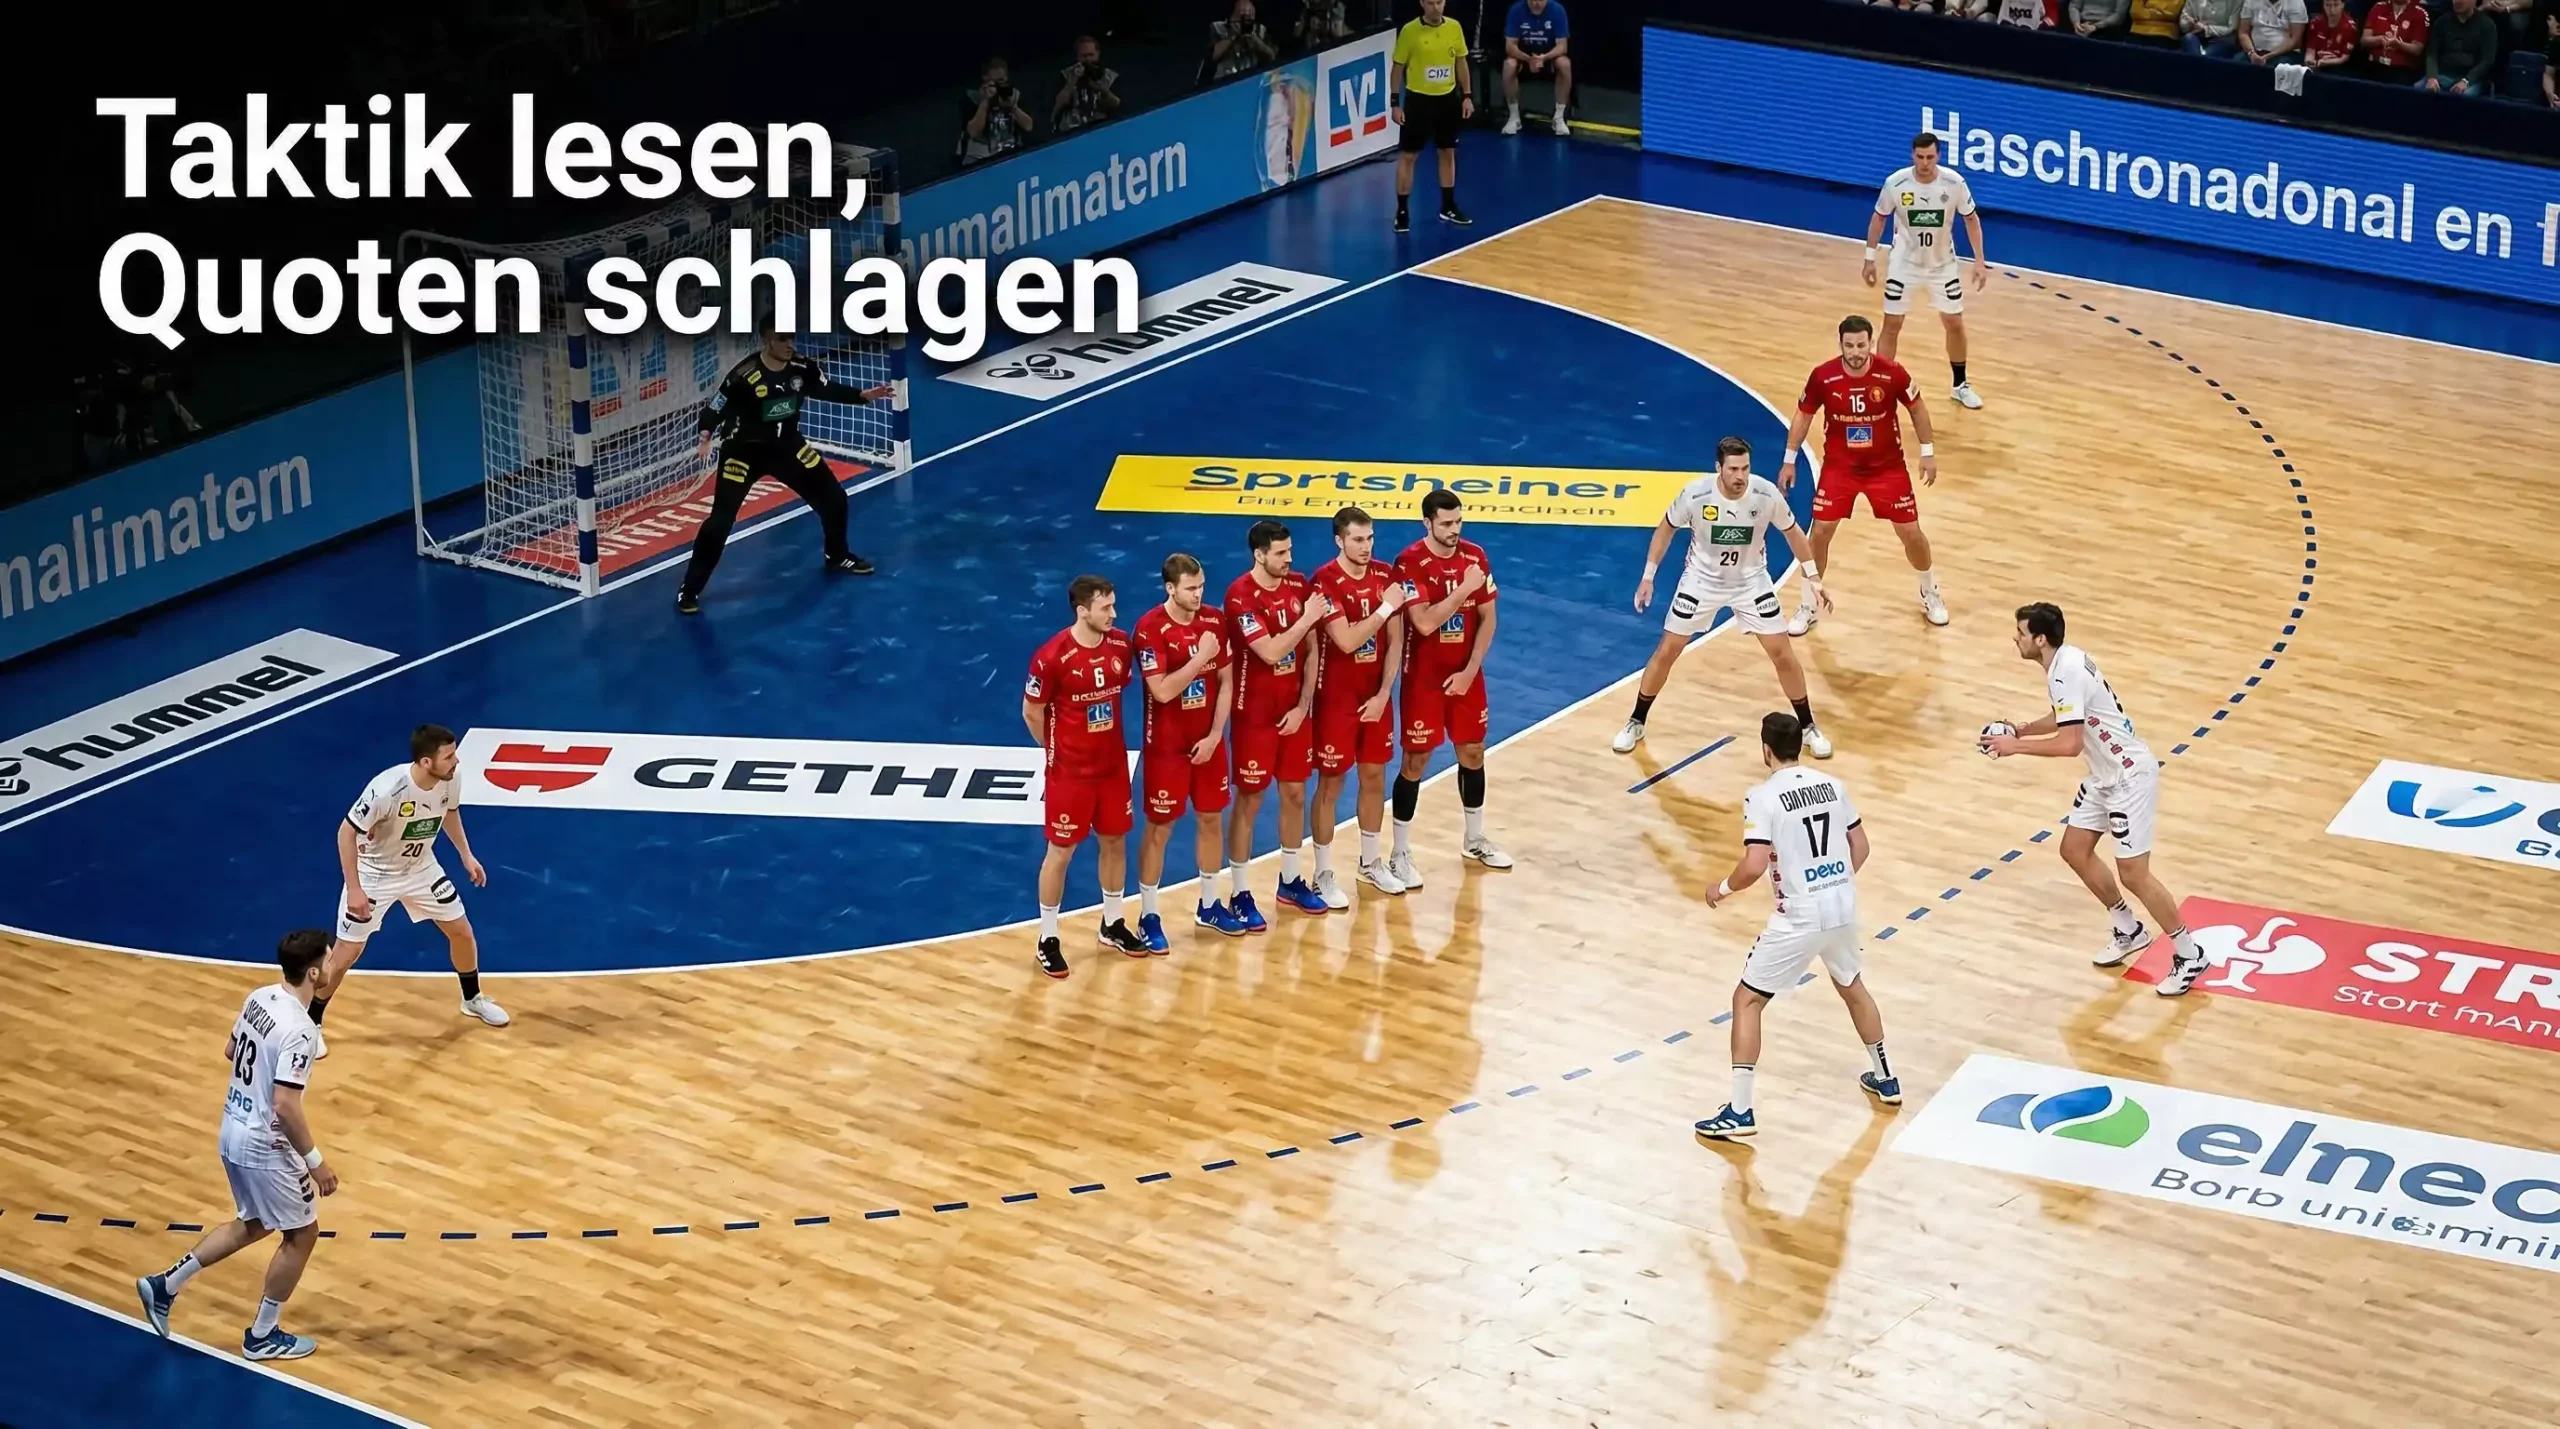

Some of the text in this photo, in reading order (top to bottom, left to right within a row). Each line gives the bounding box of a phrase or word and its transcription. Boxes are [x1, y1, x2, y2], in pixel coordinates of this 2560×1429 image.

[1921, 106, 2415, 243] Haschronadonal
[2435, 205, 2512, 259] en
[1918, 231, 1933, 247] 10
[1046, 277, 1295, 364] hummel
[1189, 466, 1641, 499] Sprtsheiner
[1719, 551, 1739, 566] 29
[1094, 667, 1105, 688] 6
[22, 654, 326, 771] hummel
[633, 758, 1046, 802] GETHE
[401, 842, 424, 858] 20
[1802, 811, 1831, 859] 17
[2350, 941, 2560, 1011] STR
[2151, 1168, 2283, 1207] Borb
